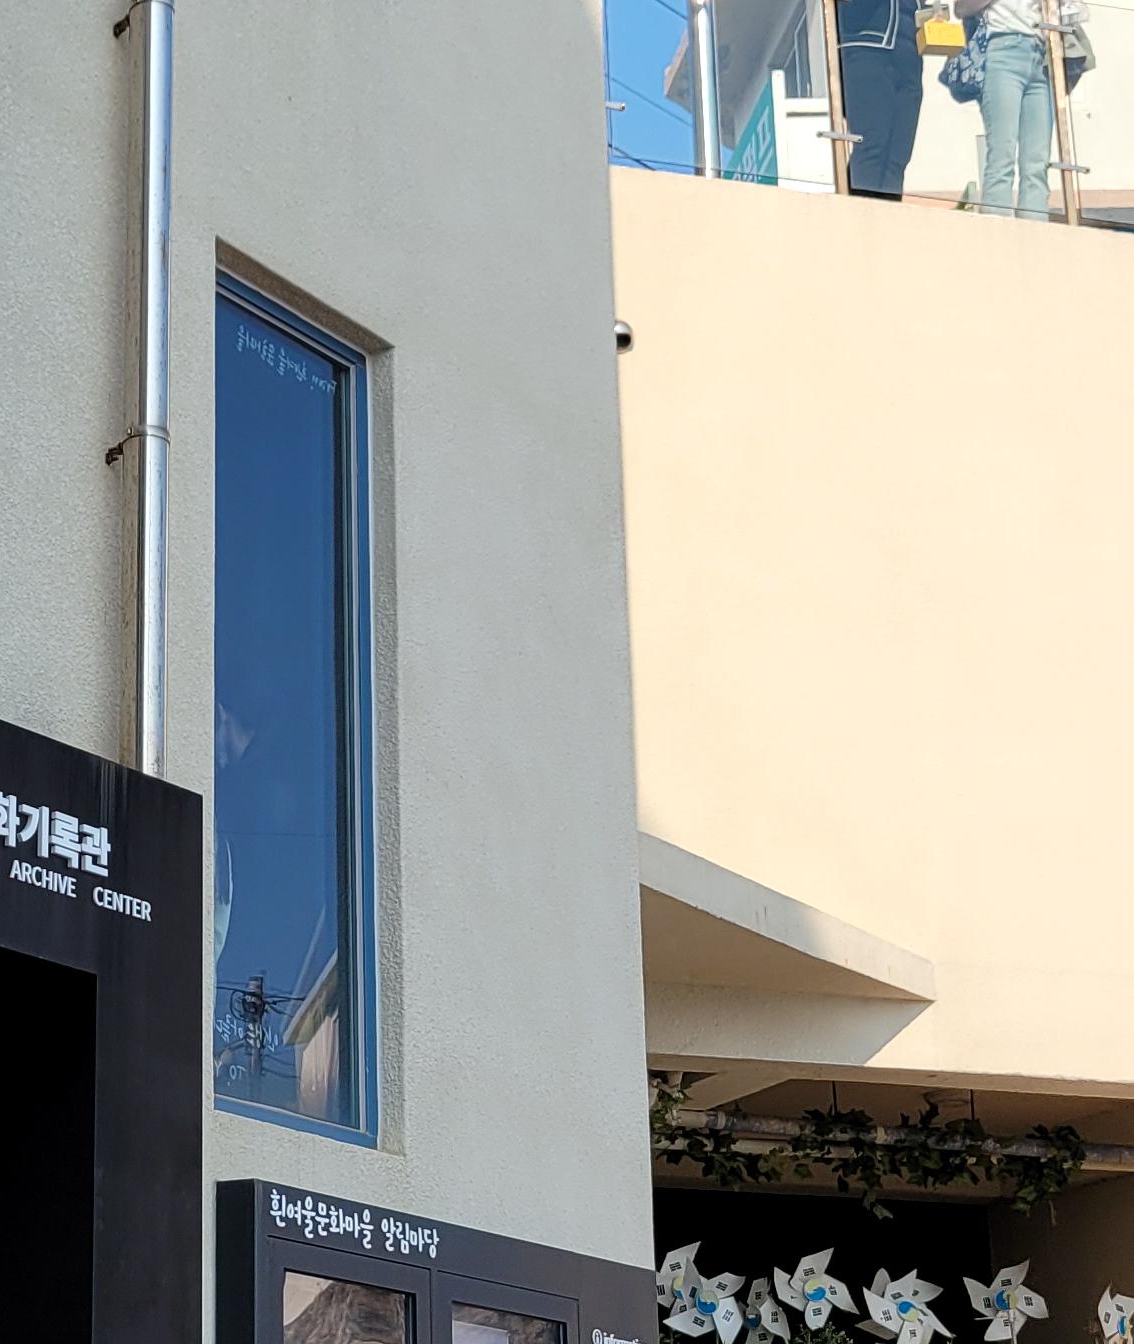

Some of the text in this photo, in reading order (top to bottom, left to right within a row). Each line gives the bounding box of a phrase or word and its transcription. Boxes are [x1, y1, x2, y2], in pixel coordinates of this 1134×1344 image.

[9, 859, 77, 898] ARCHIVE
[93, 886, 152, 922] CENTER
[269, 1188, 439, 1258] 흰여울문화마을 알림마당
